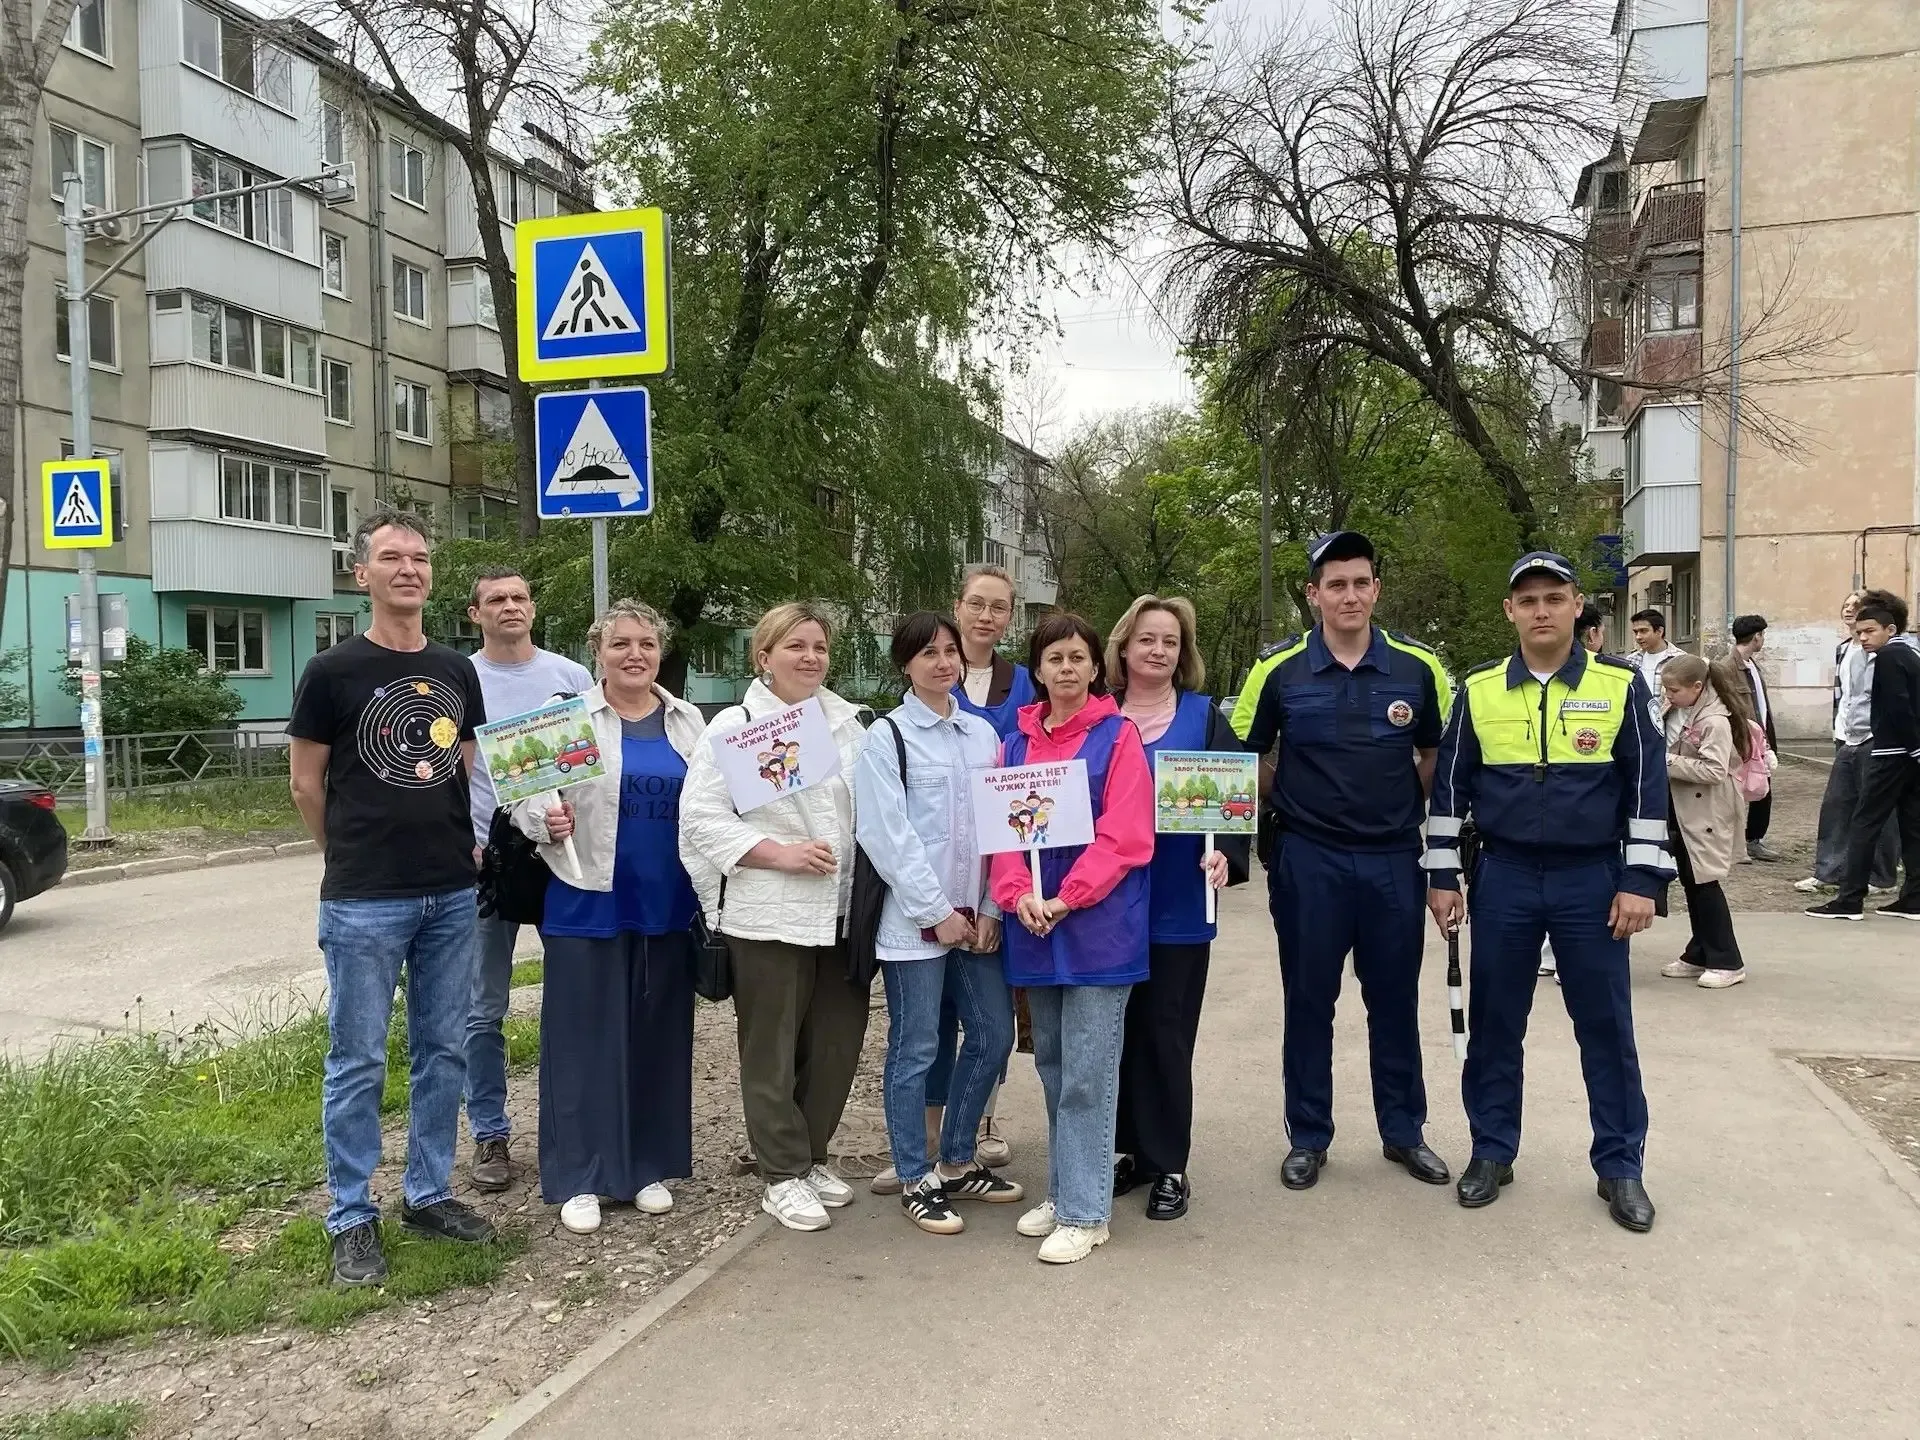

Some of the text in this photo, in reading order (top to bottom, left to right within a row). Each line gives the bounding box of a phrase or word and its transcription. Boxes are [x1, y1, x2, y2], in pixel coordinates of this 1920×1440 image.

[1563, 701, 1609, 710] ДПС ГИБДД
[530, 715, 540, 723] на
[725, 707, 804, 745] НА ДОРОГАХ НЕТ
[496, 716, 570, 743] залог безопасности
[737, 720, 801, 750] ЧУЖИХ ДЕТЕЙ!
[985, 766, 1068, 784] НА ДОРОГАХ НЕТ
[994, 777, 1062, 793] ЧУЖИХ ДЕТЕЙ!
[621, 774, 683, 797] КОЛ
